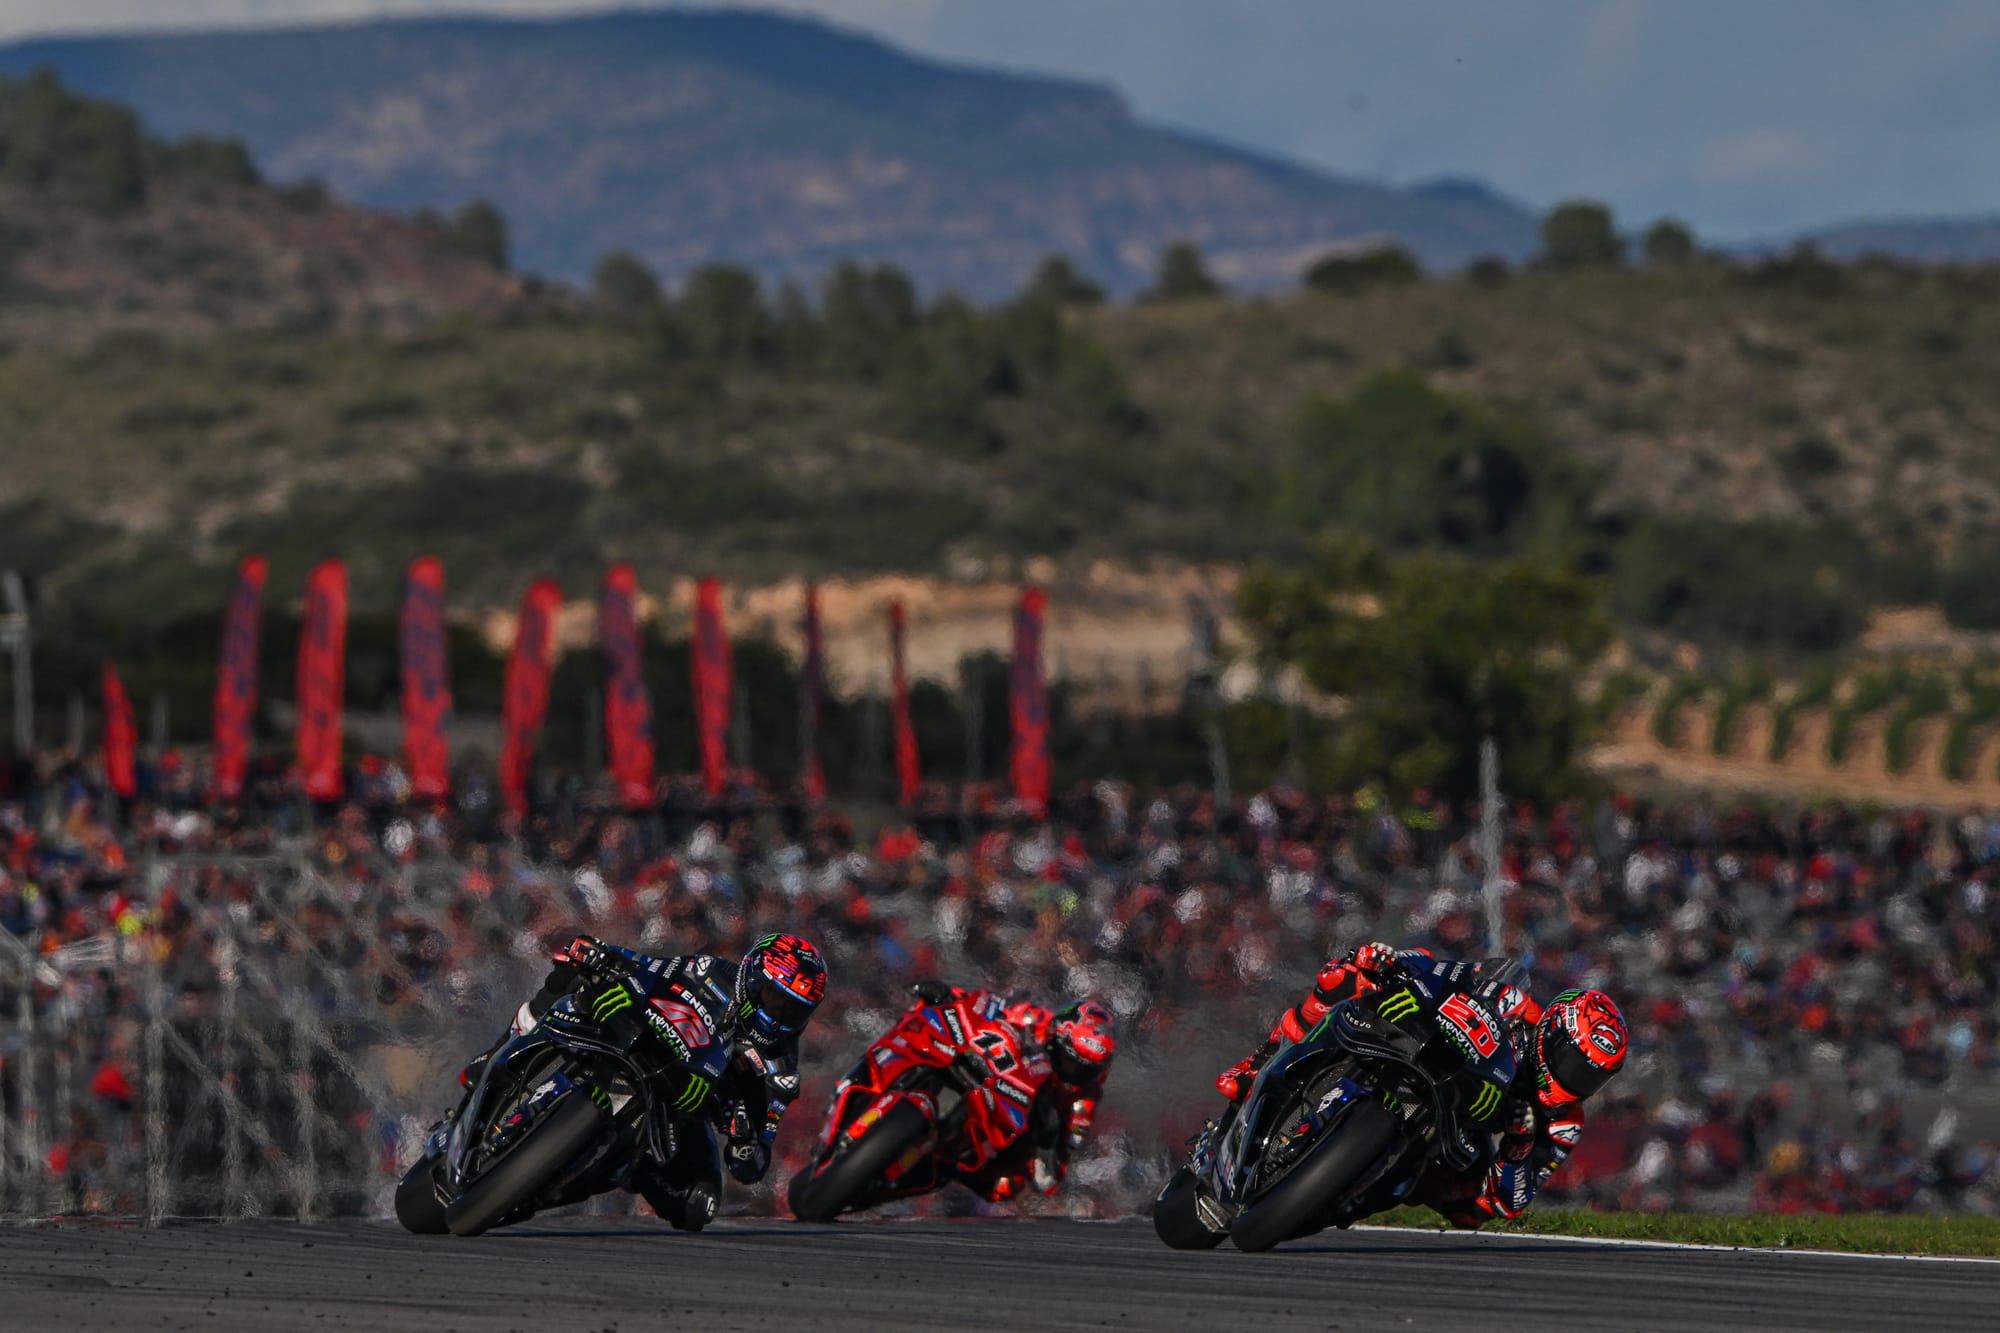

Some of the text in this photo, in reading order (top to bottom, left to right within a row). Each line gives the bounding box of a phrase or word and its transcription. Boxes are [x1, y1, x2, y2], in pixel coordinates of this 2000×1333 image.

[553, 1011, 581, 1024] REEJO
[644, 1008, 692, 1062] MONSTER
[649, 997, 711, 1049] 42
[680, 990, 716, 1035] ENEOS
[1345, 1012, 1372, 1029] REEJO
[1438, 992, 1500, 1059] 20
[1466, 998, 1501, 1043] ENEOS
[1435, 1014, 1480, 1065] MONSTER
